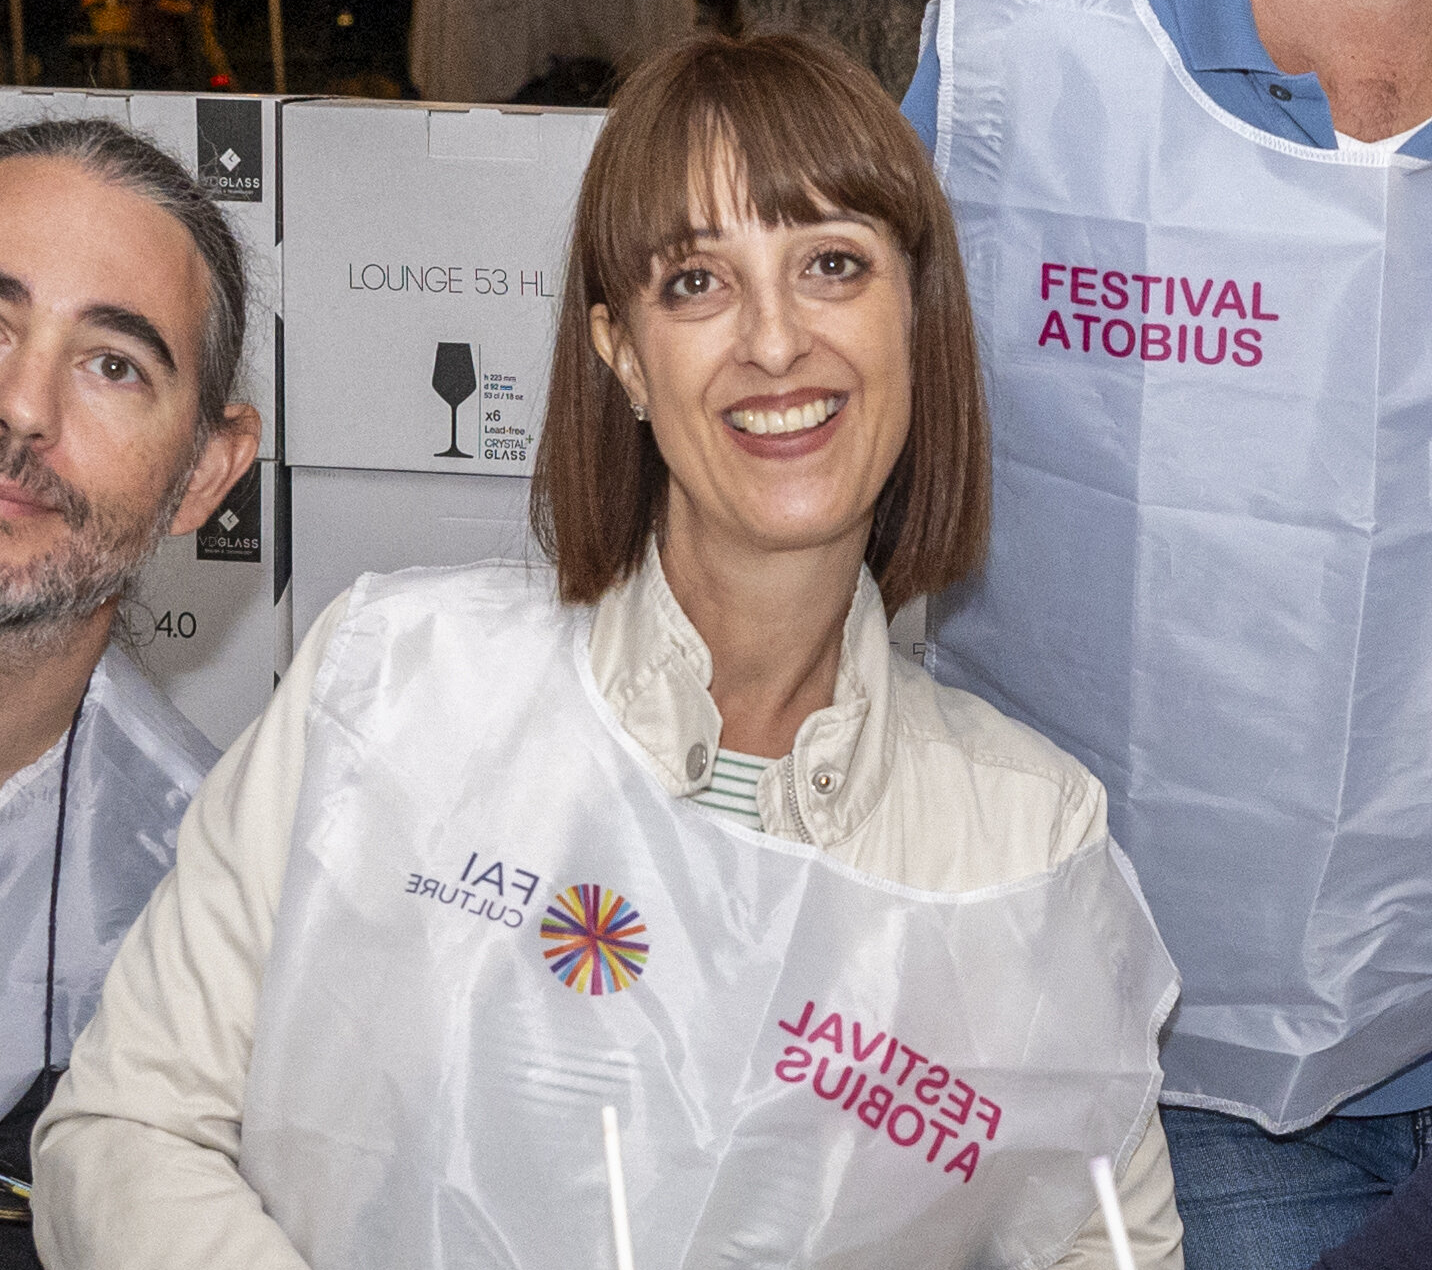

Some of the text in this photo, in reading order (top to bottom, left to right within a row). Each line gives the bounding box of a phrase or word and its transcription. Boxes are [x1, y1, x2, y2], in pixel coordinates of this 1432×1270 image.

[349, 263, 554, 297] LOUNGE 53 HL
[1040, 262, 1280, 321] FESTIVAL
[1037, 310, 1263, 367] ATOBIUS
[485, 409, 501, 421] x6
[484, 425, 525, 435] Lead-free
[484, 450, 526, 461] GLASS
[198, 536, 259, 548] VDGLASS
[155, 611, 196, 638] 4.0
